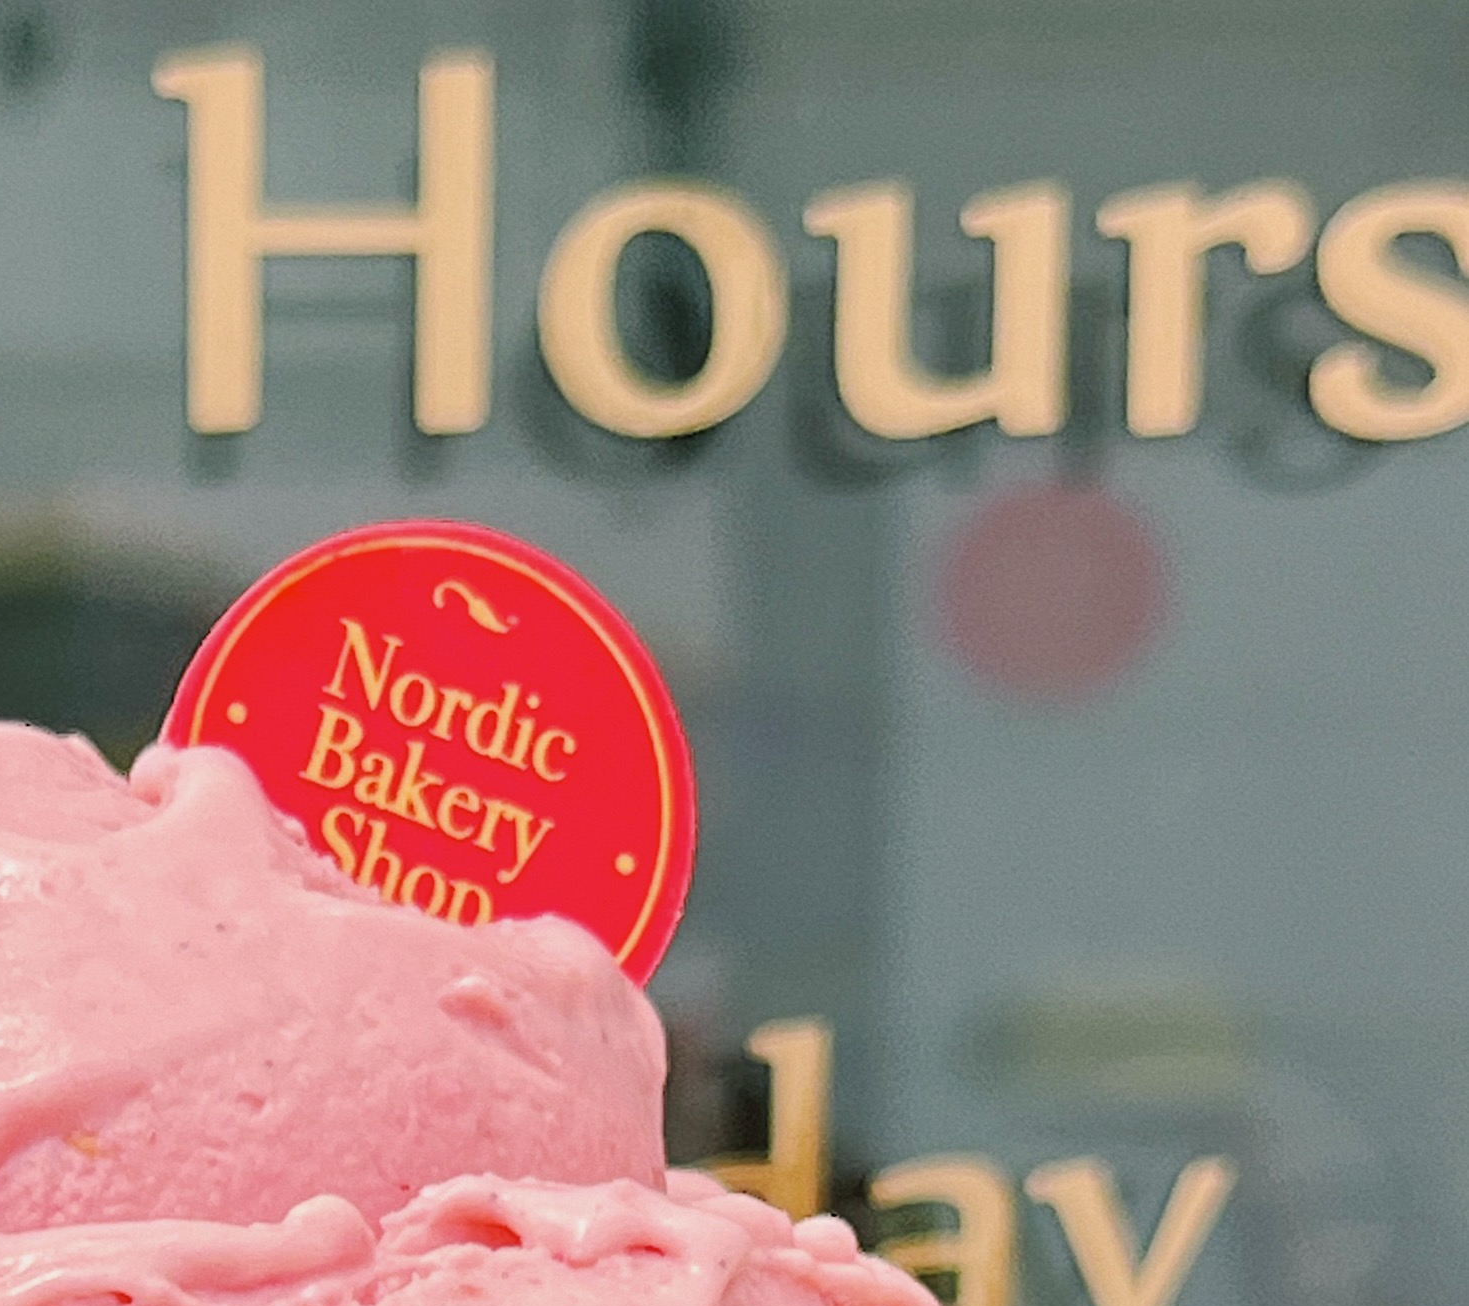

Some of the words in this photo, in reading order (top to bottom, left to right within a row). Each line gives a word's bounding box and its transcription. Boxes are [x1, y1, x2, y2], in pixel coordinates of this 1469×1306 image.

[150, 42, 1469, 440] Hours
[322, 618, 576, 782] Nordic
[299, 704, 554, 884] Bakery
